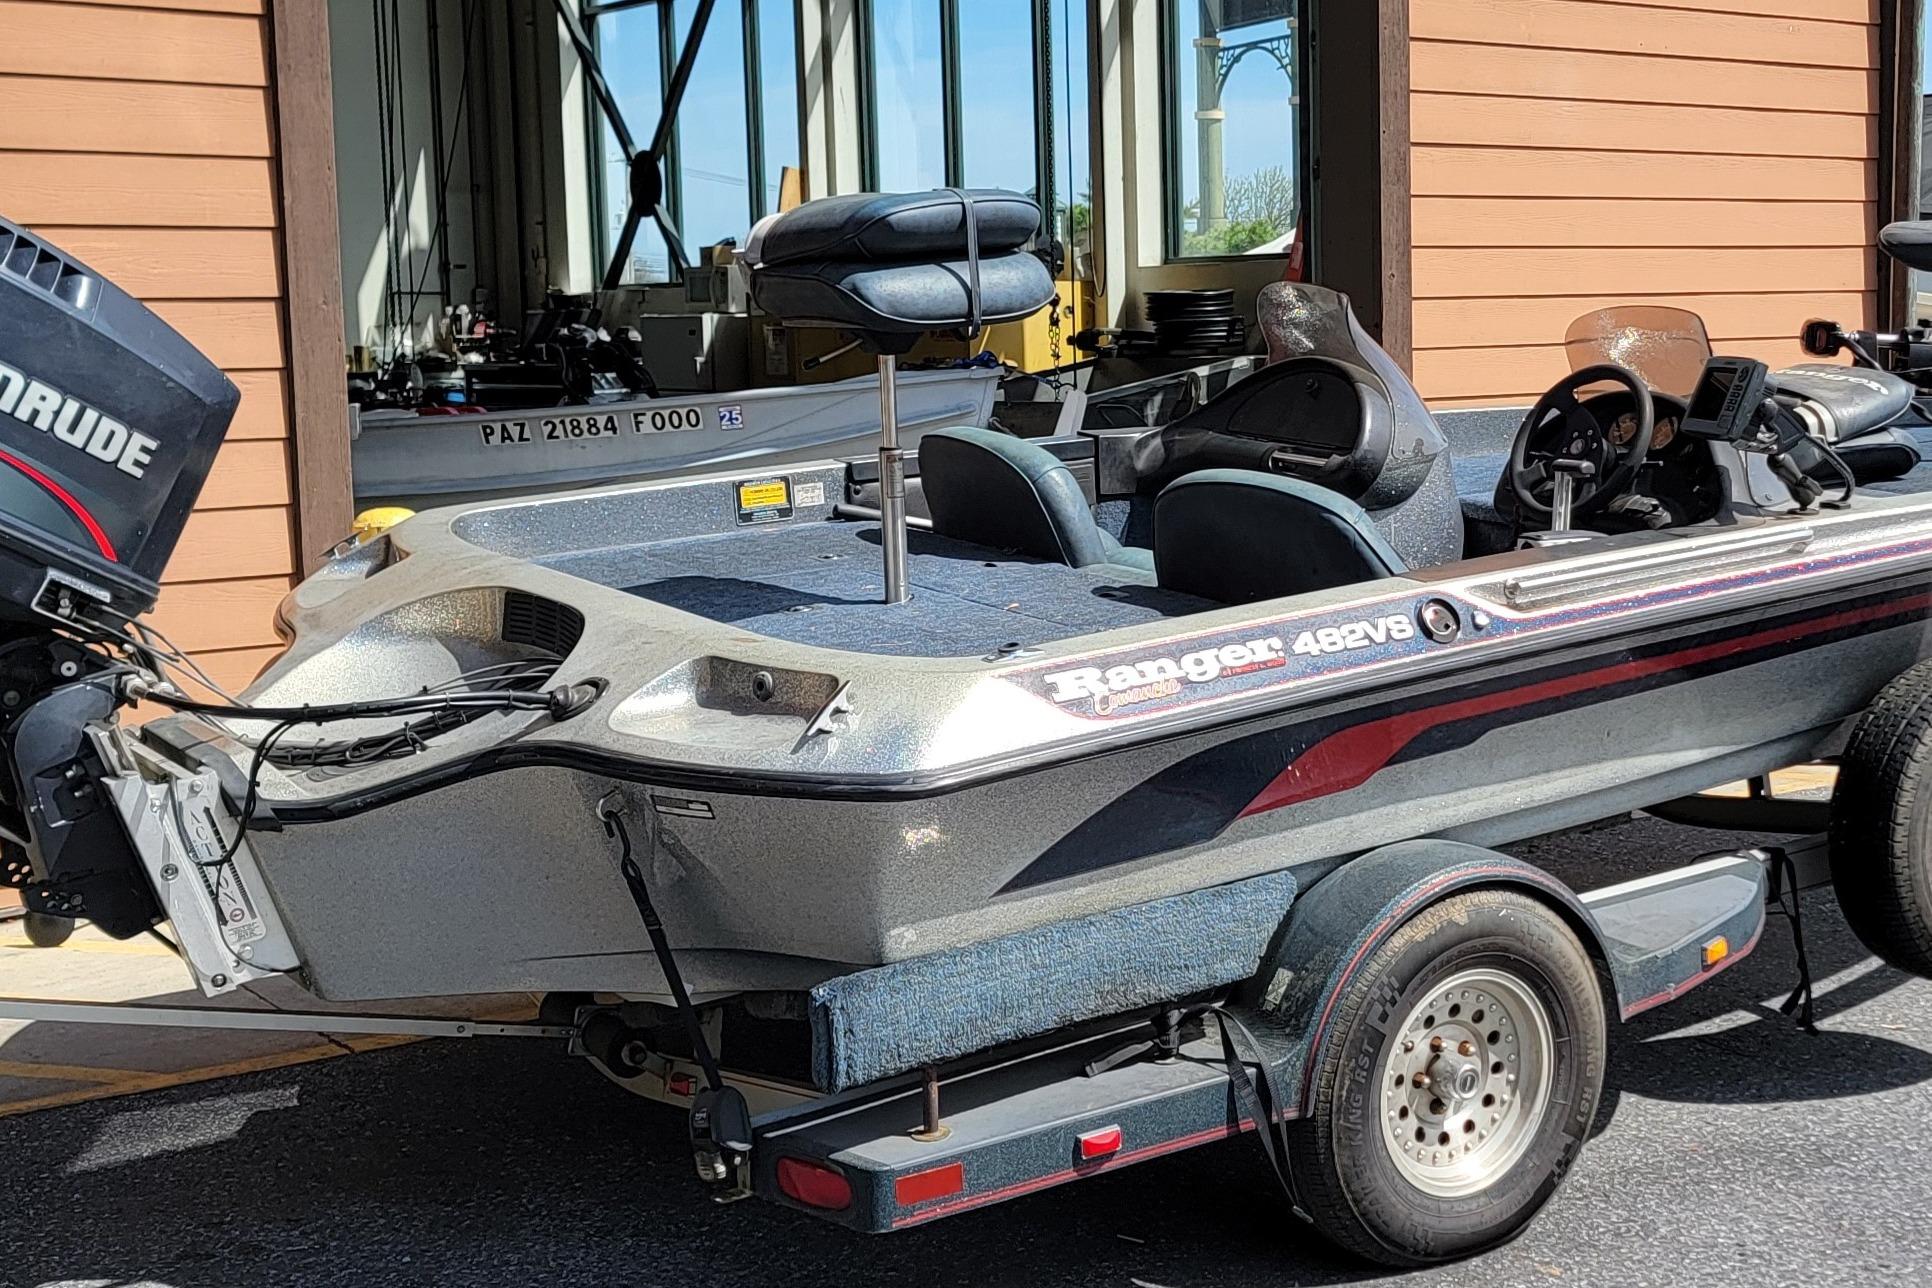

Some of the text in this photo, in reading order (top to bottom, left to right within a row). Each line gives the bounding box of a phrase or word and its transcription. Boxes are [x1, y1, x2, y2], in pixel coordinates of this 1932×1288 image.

[480, 422, 531, 445] PAZ
[542, 415, 618, 440] 21884
[720, 410, 742, 426] 25
[1043, 614, 1414, 704] Ranger 482VS
[1354, 1038, 1375, 1084] RST
[1350, 1091, 1364, 1146] KING
